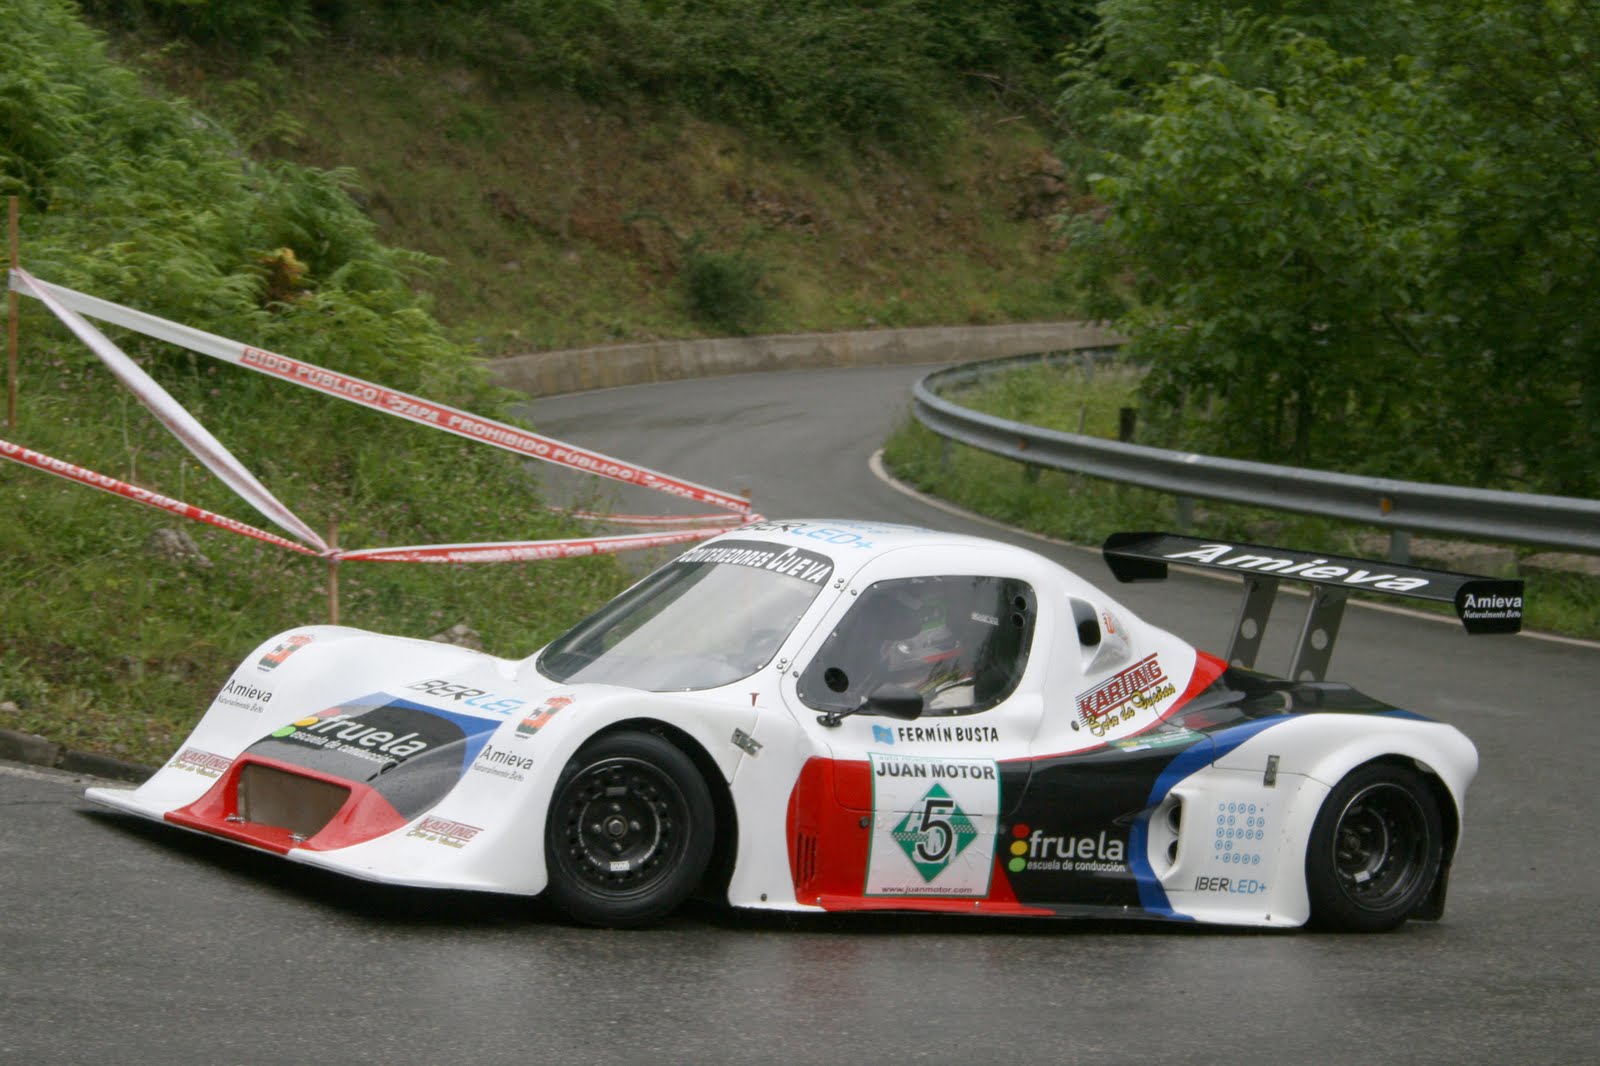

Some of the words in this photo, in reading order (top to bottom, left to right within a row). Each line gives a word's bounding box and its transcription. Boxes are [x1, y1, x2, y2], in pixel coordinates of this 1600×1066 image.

[448, 415, 549, 456] PROHIBIDO
[1164, 544, 1430, 592] Amieva
[1464, 593, 1522, 608] Amieva
[1463, 609, 1506, 619] Naturalmente
[223, 679, 273, 703] Amieva
[1078, 655, 1165, 720] KARTING
[307, 714, 428, 758] fruela
[898, 723, 952, 742] FERMÍN
[956, 726, 999, 743] BUSTA
[479, 744, 534, 771] Amieva
[876, 762, 926, 778] JUAN
[931, 763, 996, 781] MOTOR
[916, 799, 955, 863] 5
[1029, 829, 1125, 861] fruela
[1027, 859, 1060, 870] escuela
[1062, 859, 1073, 870] de
[881, 885, 974, 895] www.juanmotor.com
